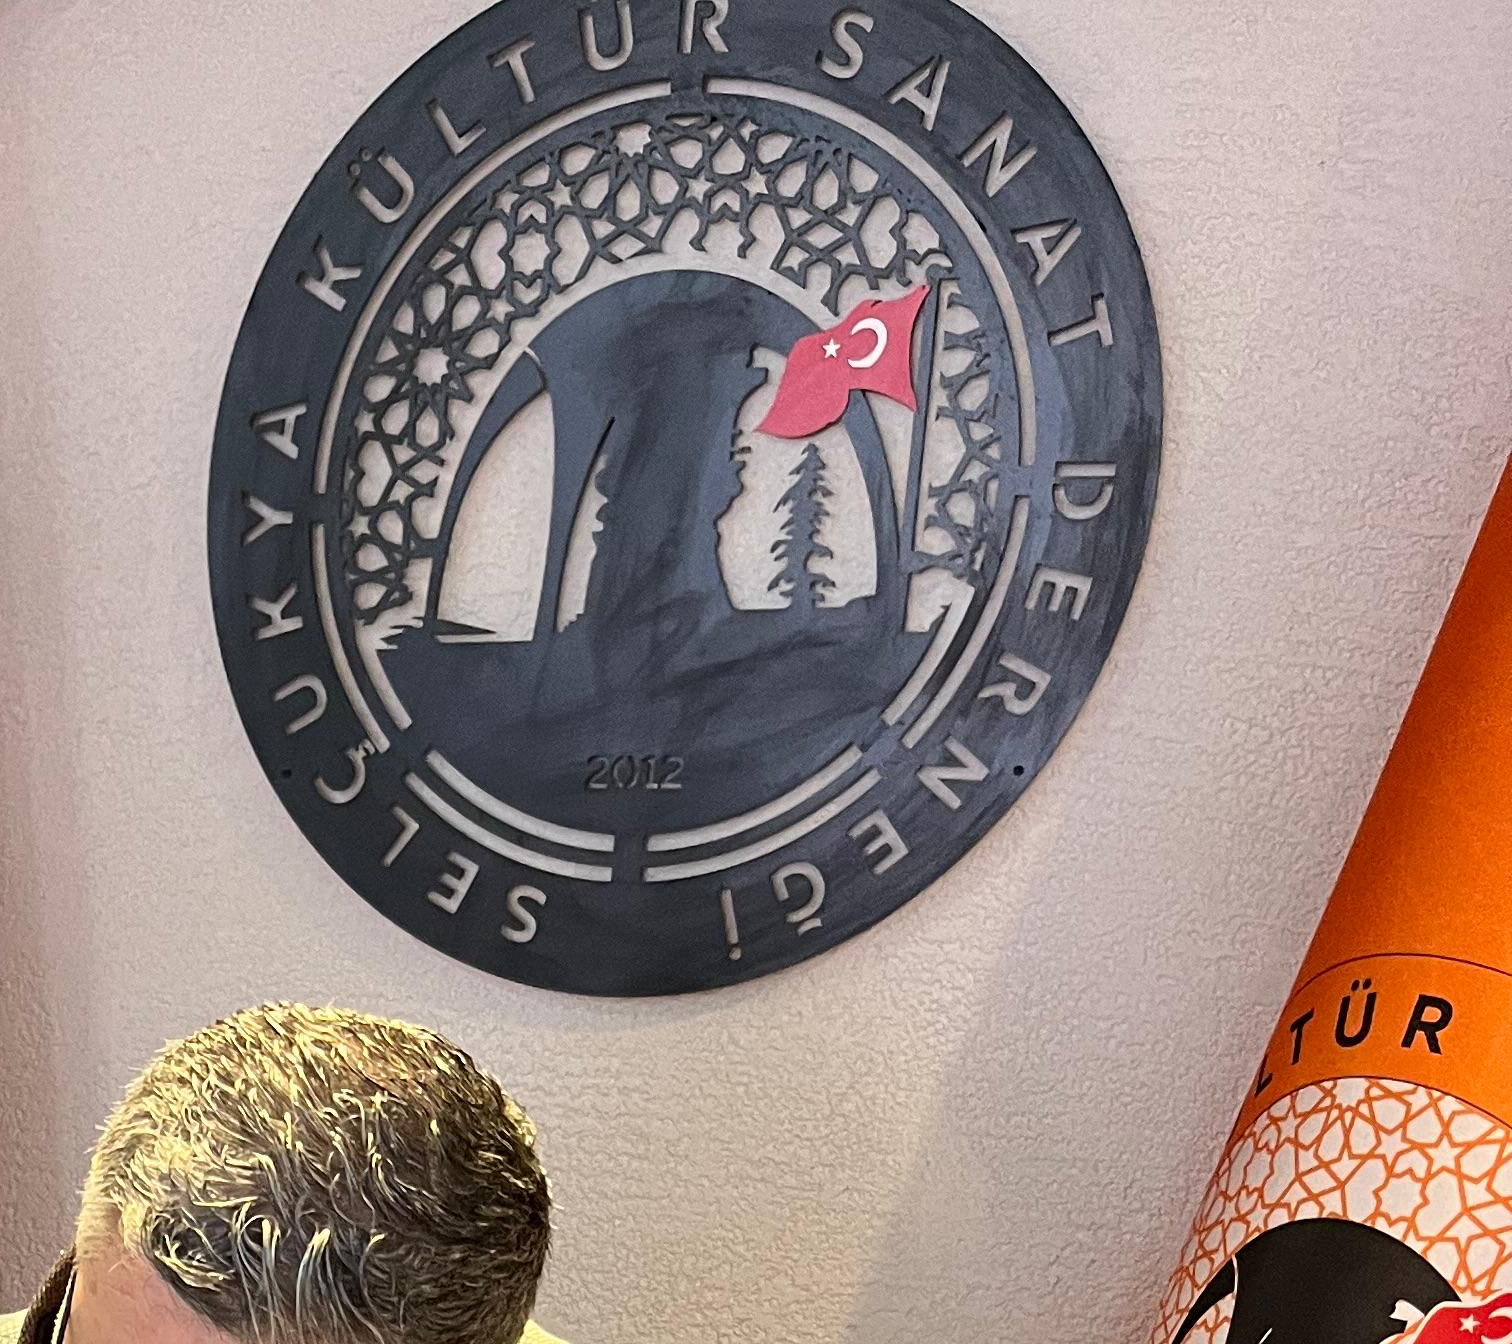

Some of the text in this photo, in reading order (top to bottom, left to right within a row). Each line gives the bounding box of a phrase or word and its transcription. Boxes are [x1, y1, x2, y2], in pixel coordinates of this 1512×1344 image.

[816, 12, 1114, 349] SANAT
[240, 404, 546, 943] SELÇUKYA
[584, 753, 685, 792] 2012
[720, 460, 1116, 960] DERNEĞİ
